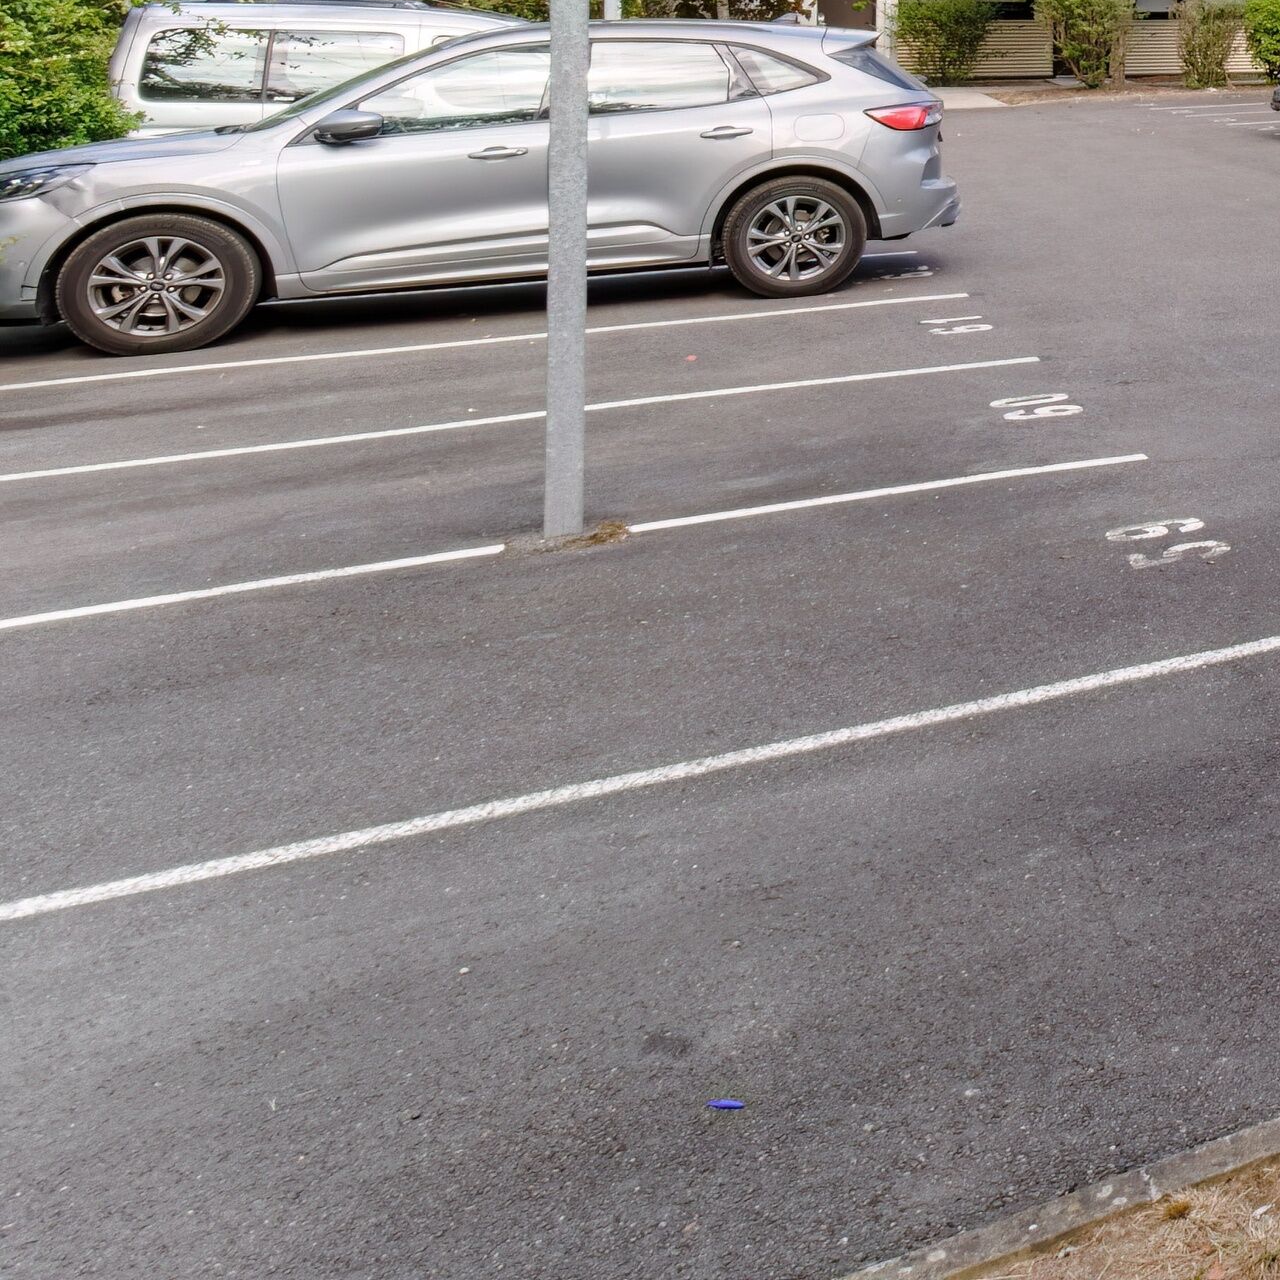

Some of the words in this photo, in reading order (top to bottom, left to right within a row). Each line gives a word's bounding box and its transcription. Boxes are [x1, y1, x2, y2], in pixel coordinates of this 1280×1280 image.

[919, 315, 993, 335] 61
[989, 392, 1083, 420] 60
[1105, 517, 1231, 568] 59
